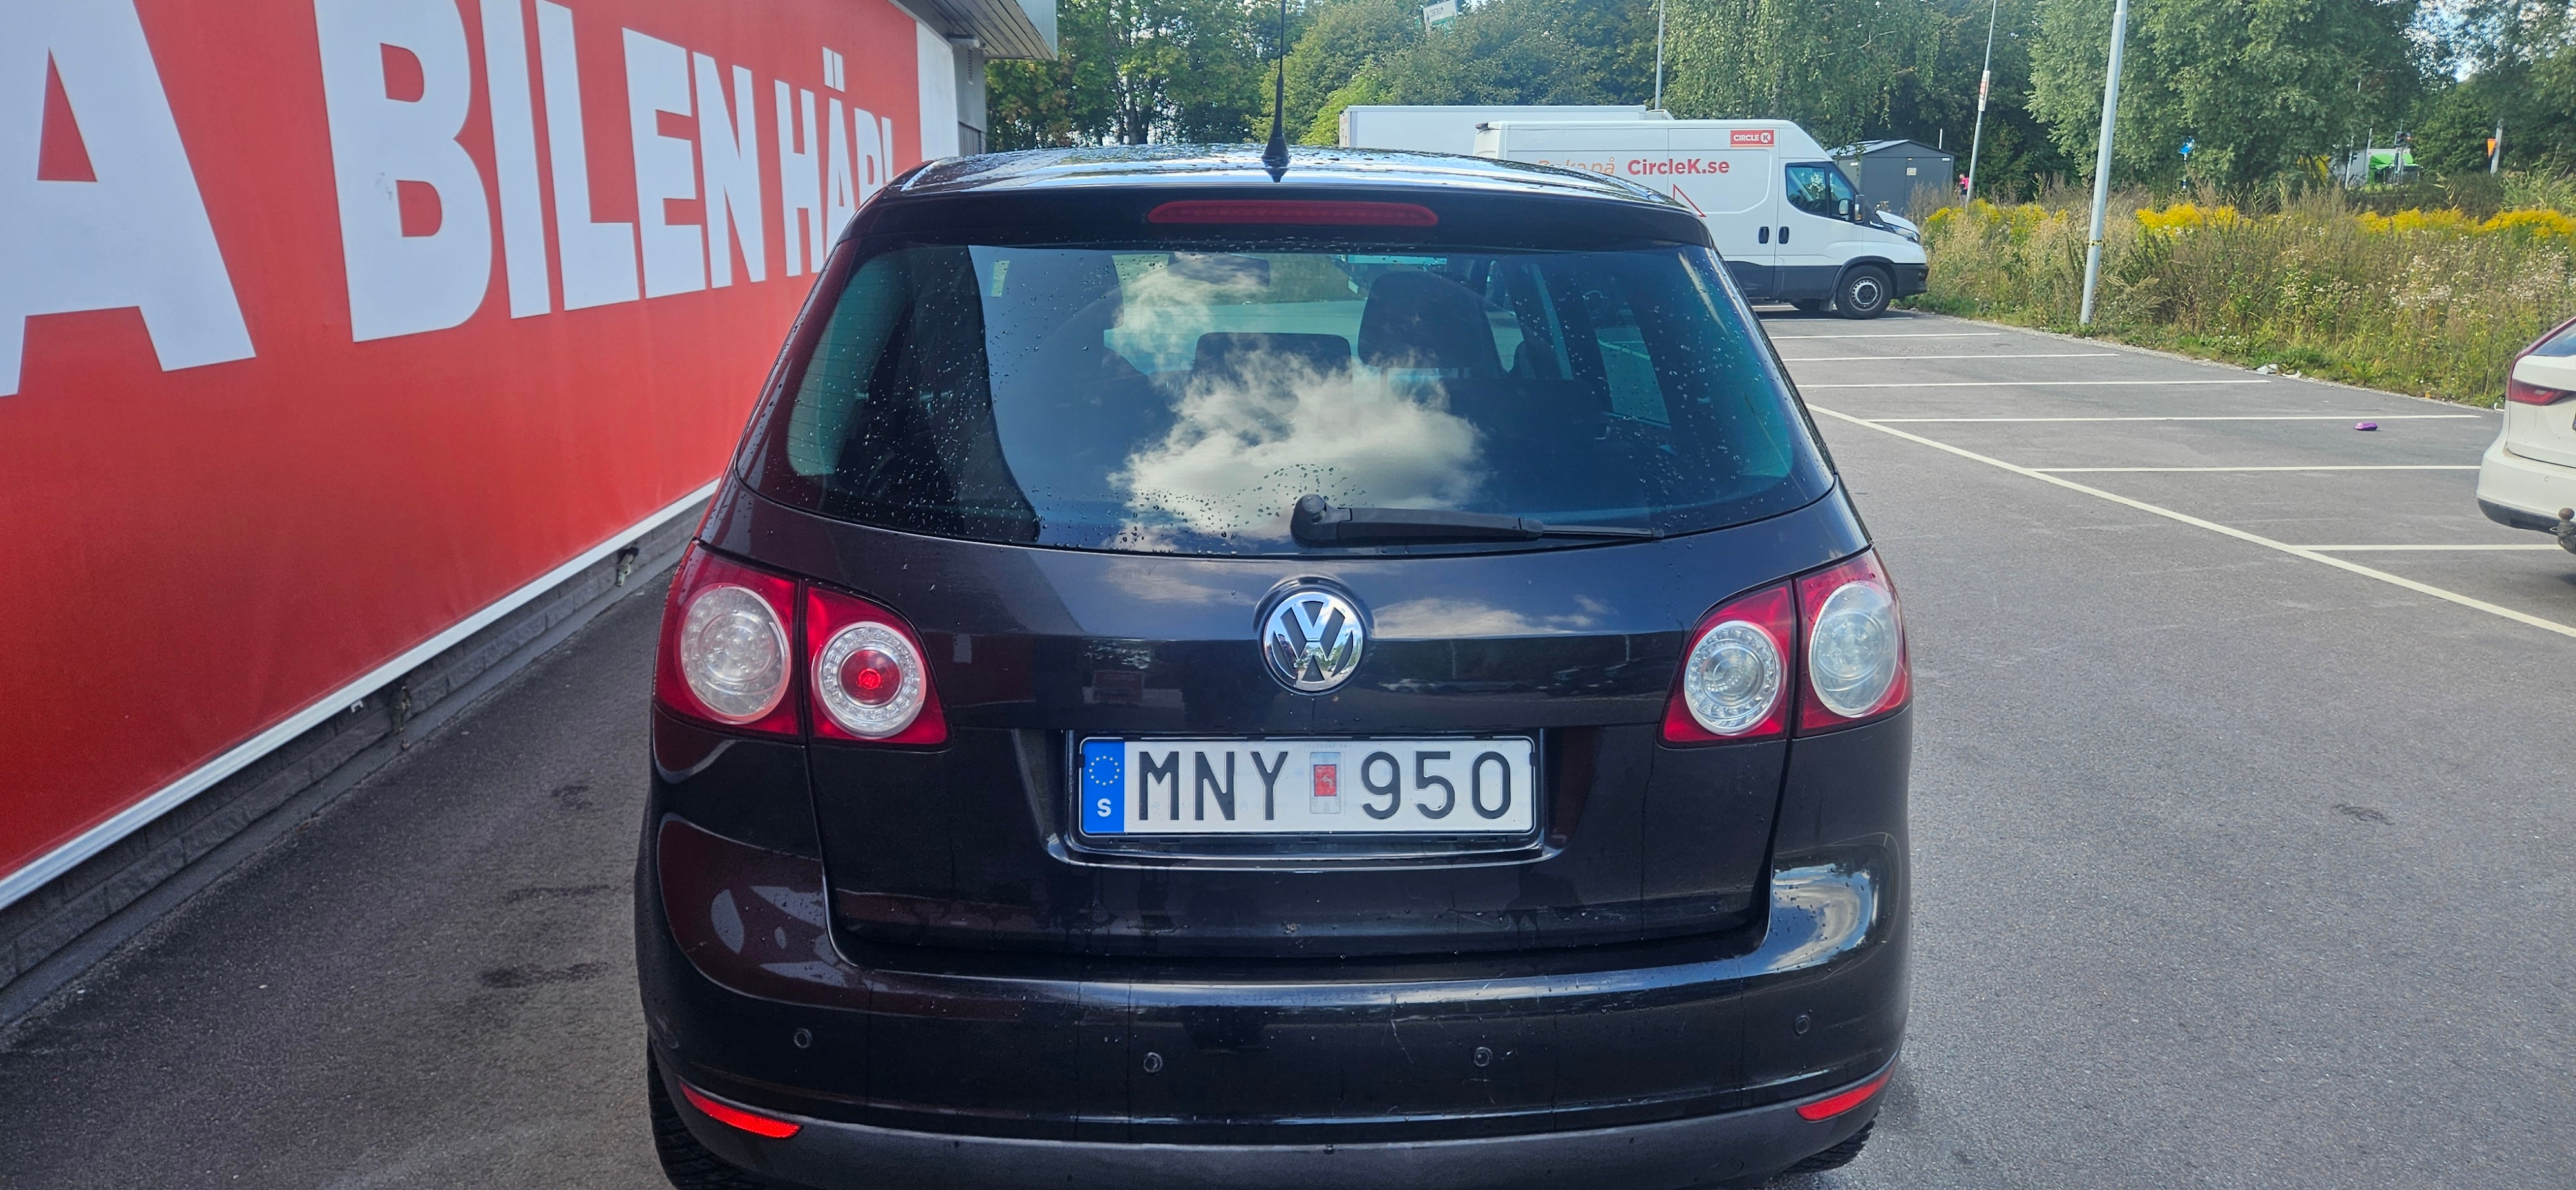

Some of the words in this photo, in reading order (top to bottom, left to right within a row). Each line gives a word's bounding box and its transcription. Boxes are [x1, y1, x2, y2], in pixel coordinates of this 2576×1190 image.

[314, 0, 766, 343] BILEN
[1627, 158, 1730, 175] CircleK.se
[1097, 798, 1112, 817] S
[1139, 751, 1289, 820] MNY
[1360, 751, 1511, 820] 950
